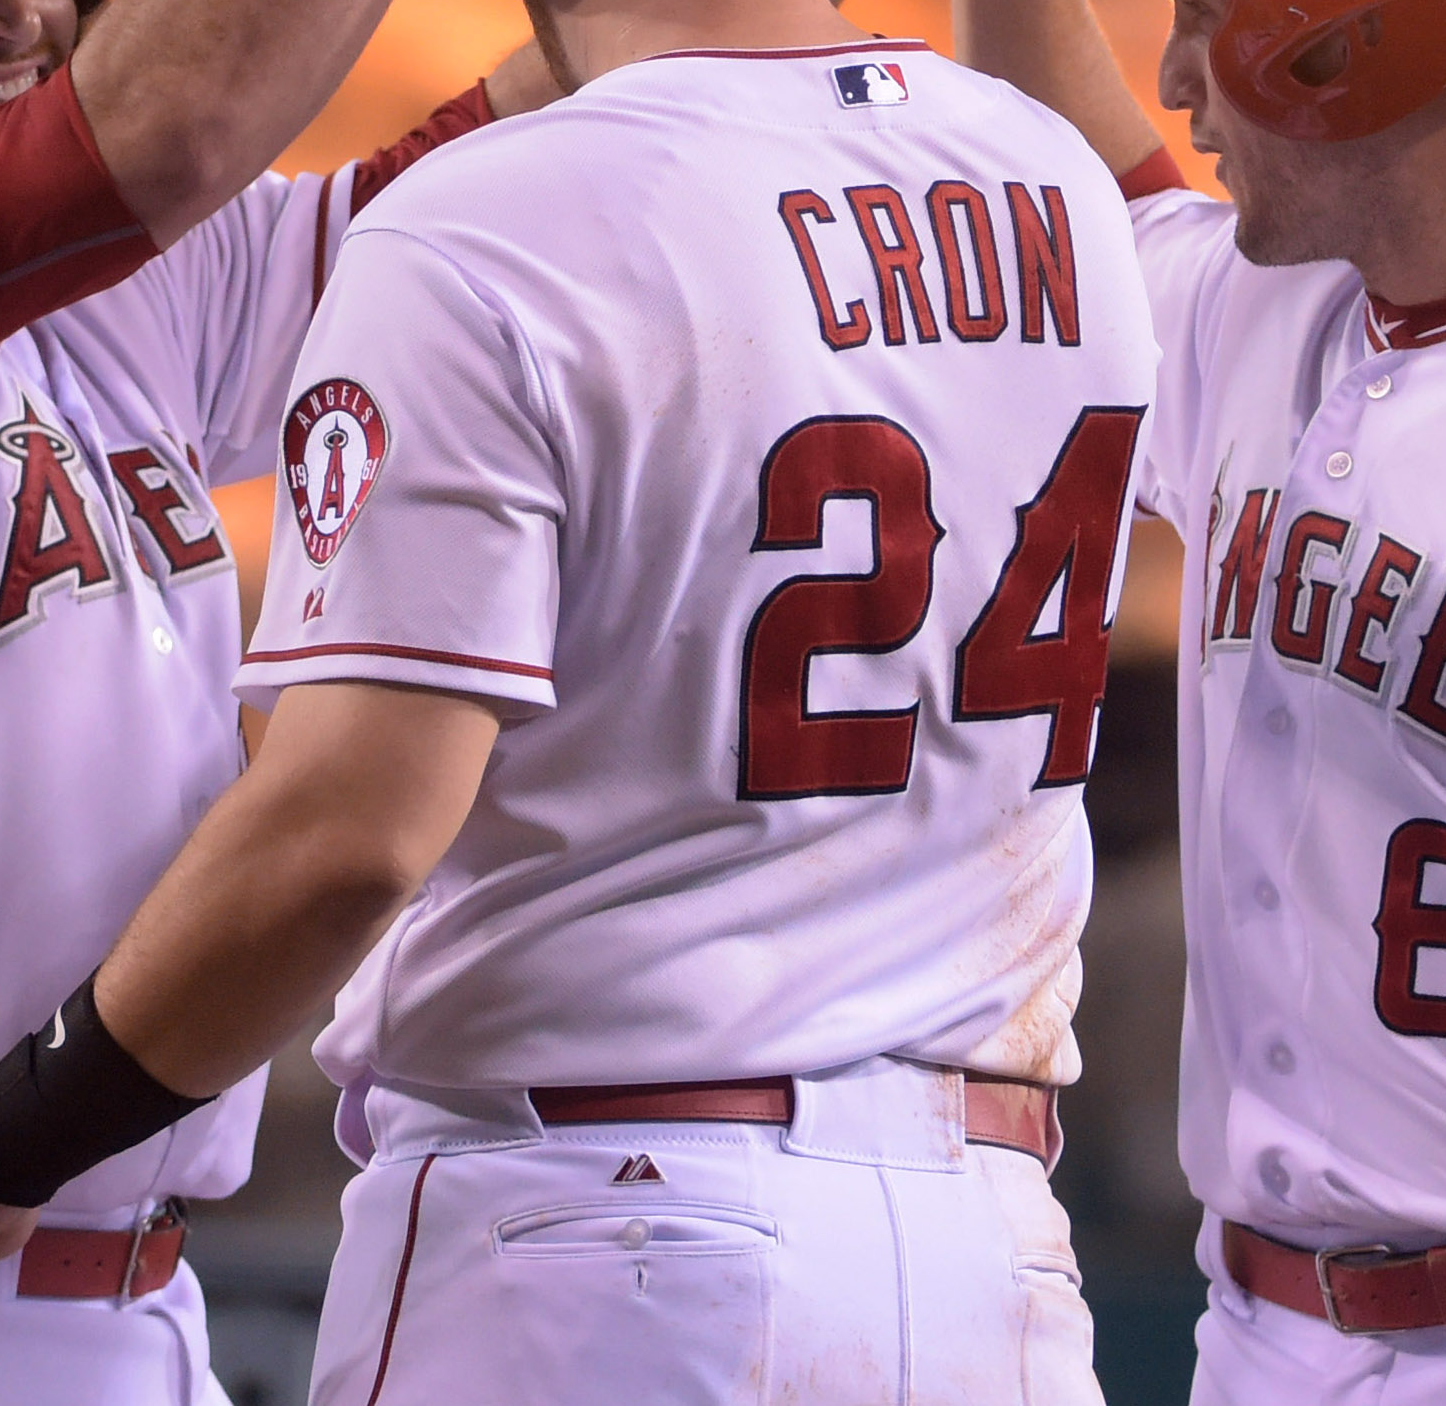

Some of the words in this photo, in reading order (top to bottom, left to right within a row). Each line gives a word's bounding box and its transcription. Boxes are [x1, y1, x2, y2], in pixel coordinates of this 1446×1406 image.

[778, 180, 1082, 352] CRON
[296, 385, 374, 430] ANGELS
[290, 463, 308, 489] 19
[361, 457, 380, 481] 61
[737, 404, 1151, 802] 24
